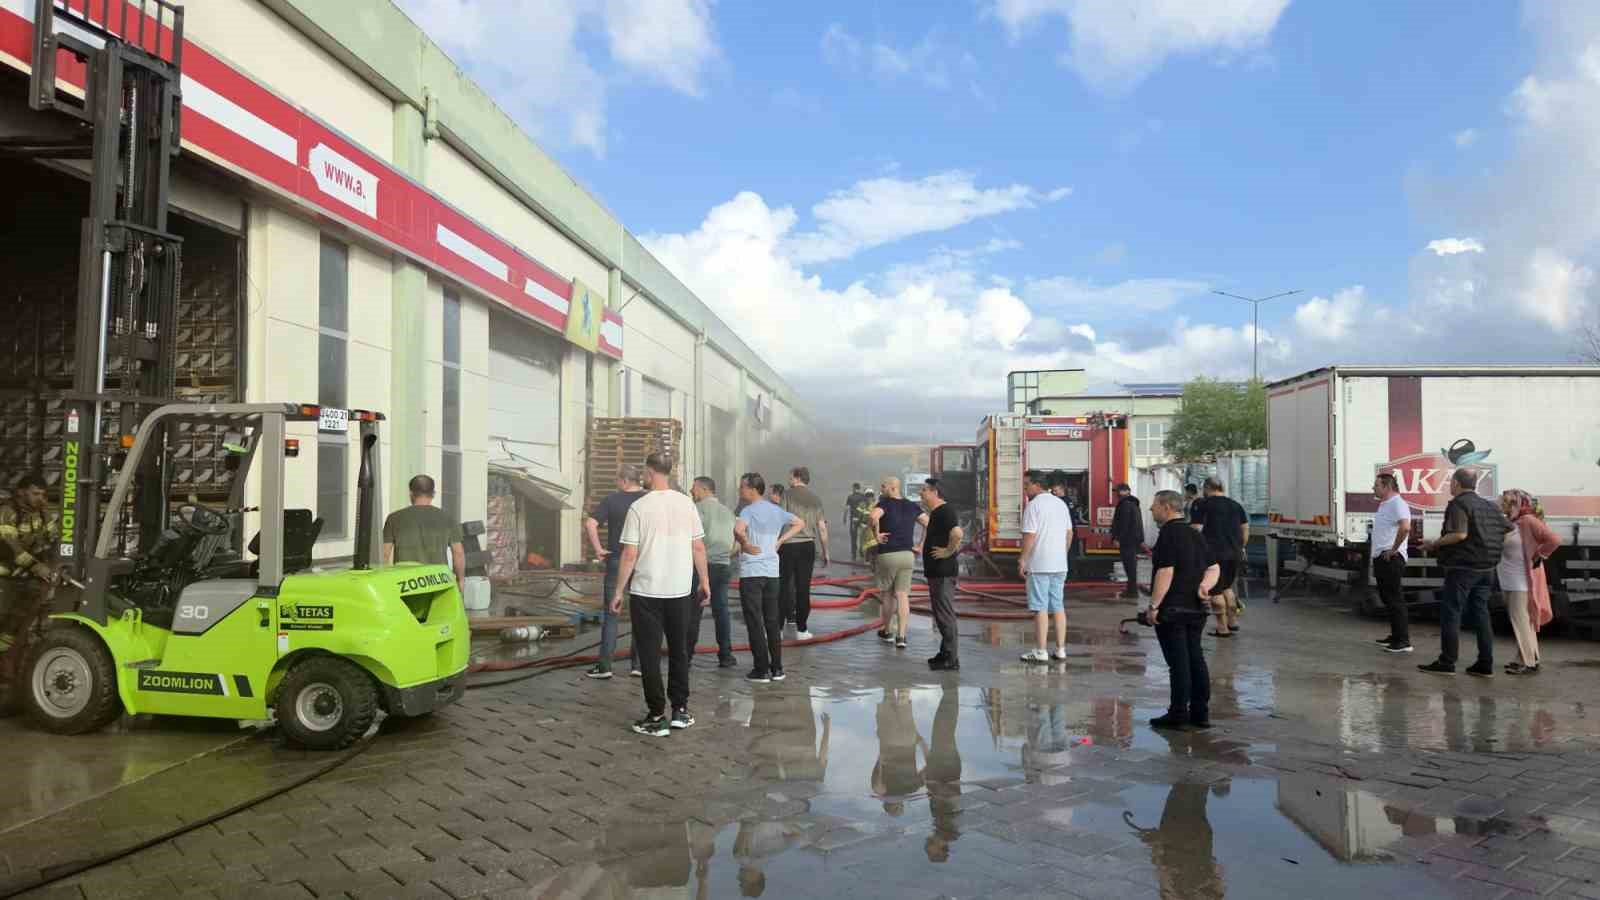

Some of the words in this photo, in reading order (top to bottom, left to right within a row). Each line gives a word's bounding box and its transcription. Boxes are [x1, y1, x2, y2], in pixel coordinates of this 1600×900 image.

[62, 440, 80, 543] ZOOMLION
[180, 605, 209, 620] 30
[143, 675, 214, 690] ZOOMLION
